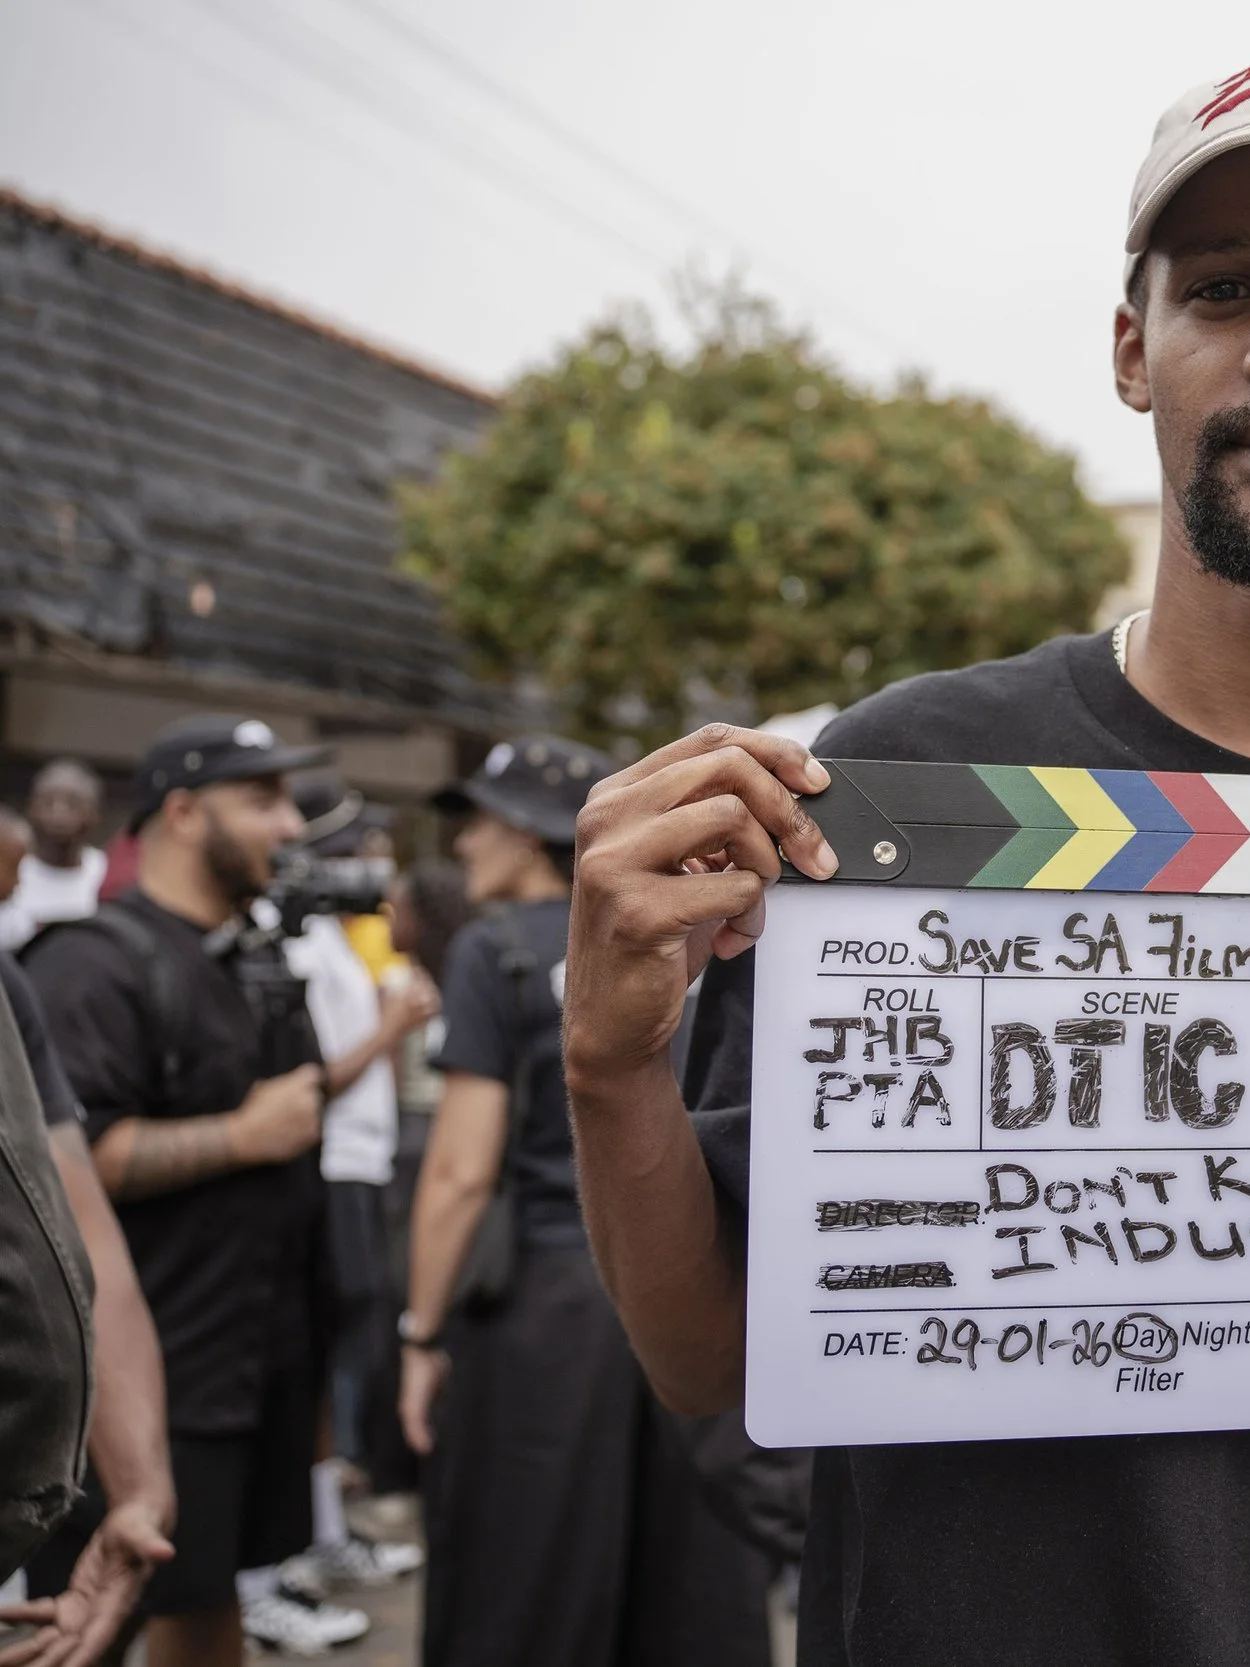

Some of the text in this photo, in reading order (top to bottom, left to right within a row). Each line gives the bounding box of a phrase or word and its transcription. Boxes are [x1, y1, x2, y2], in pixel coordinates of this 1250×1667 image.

[820, 940, 915, 966] PROD.
[1055, 912, 1133, 974] SA
[863, 988, 940, 1013] ROLL
[1081, 992, 1180, 1016] SCENE
[805, 1014, 955, 1067] JHB
[986, 1017, 1246, 1131] DTIC
[813, 1069, 952, 1131] PTA
[824, 1331, 908, 1357] DATE:
[917, 1316, 1112, 1371] 29-01-26
[1118, 1322, 1171, 1354] Day
[1116, 1366, 1184, 1393] Filter
